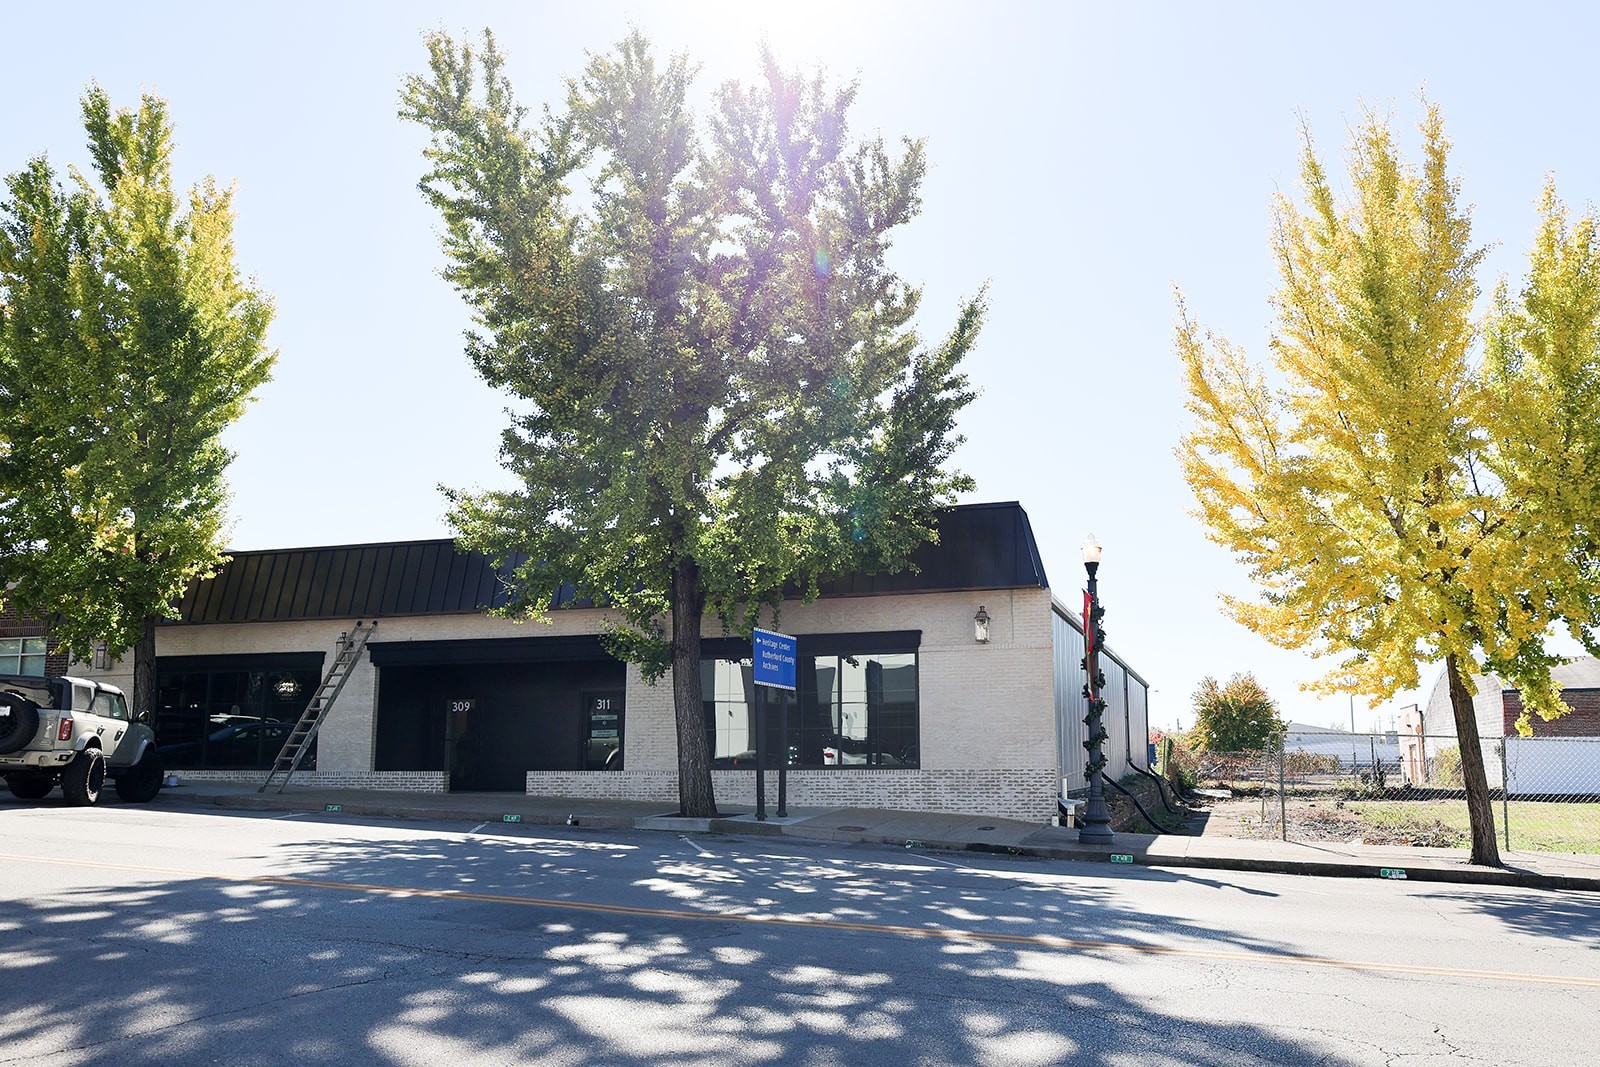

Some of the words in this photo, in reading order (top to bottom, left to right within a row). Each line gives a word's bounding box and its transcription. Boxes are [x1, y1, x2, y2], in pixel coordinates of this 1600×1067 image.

[762, 638, 778, 649] Heritage
[779, 642, 791, 651] Center
[762, 650, 782, 661] Rutherford
[782, 655, 795, 666] County
[762, 661, 779, 671] Archives
[452, 701, 470, 712] 309
[596, 699, 610, 710] 311
